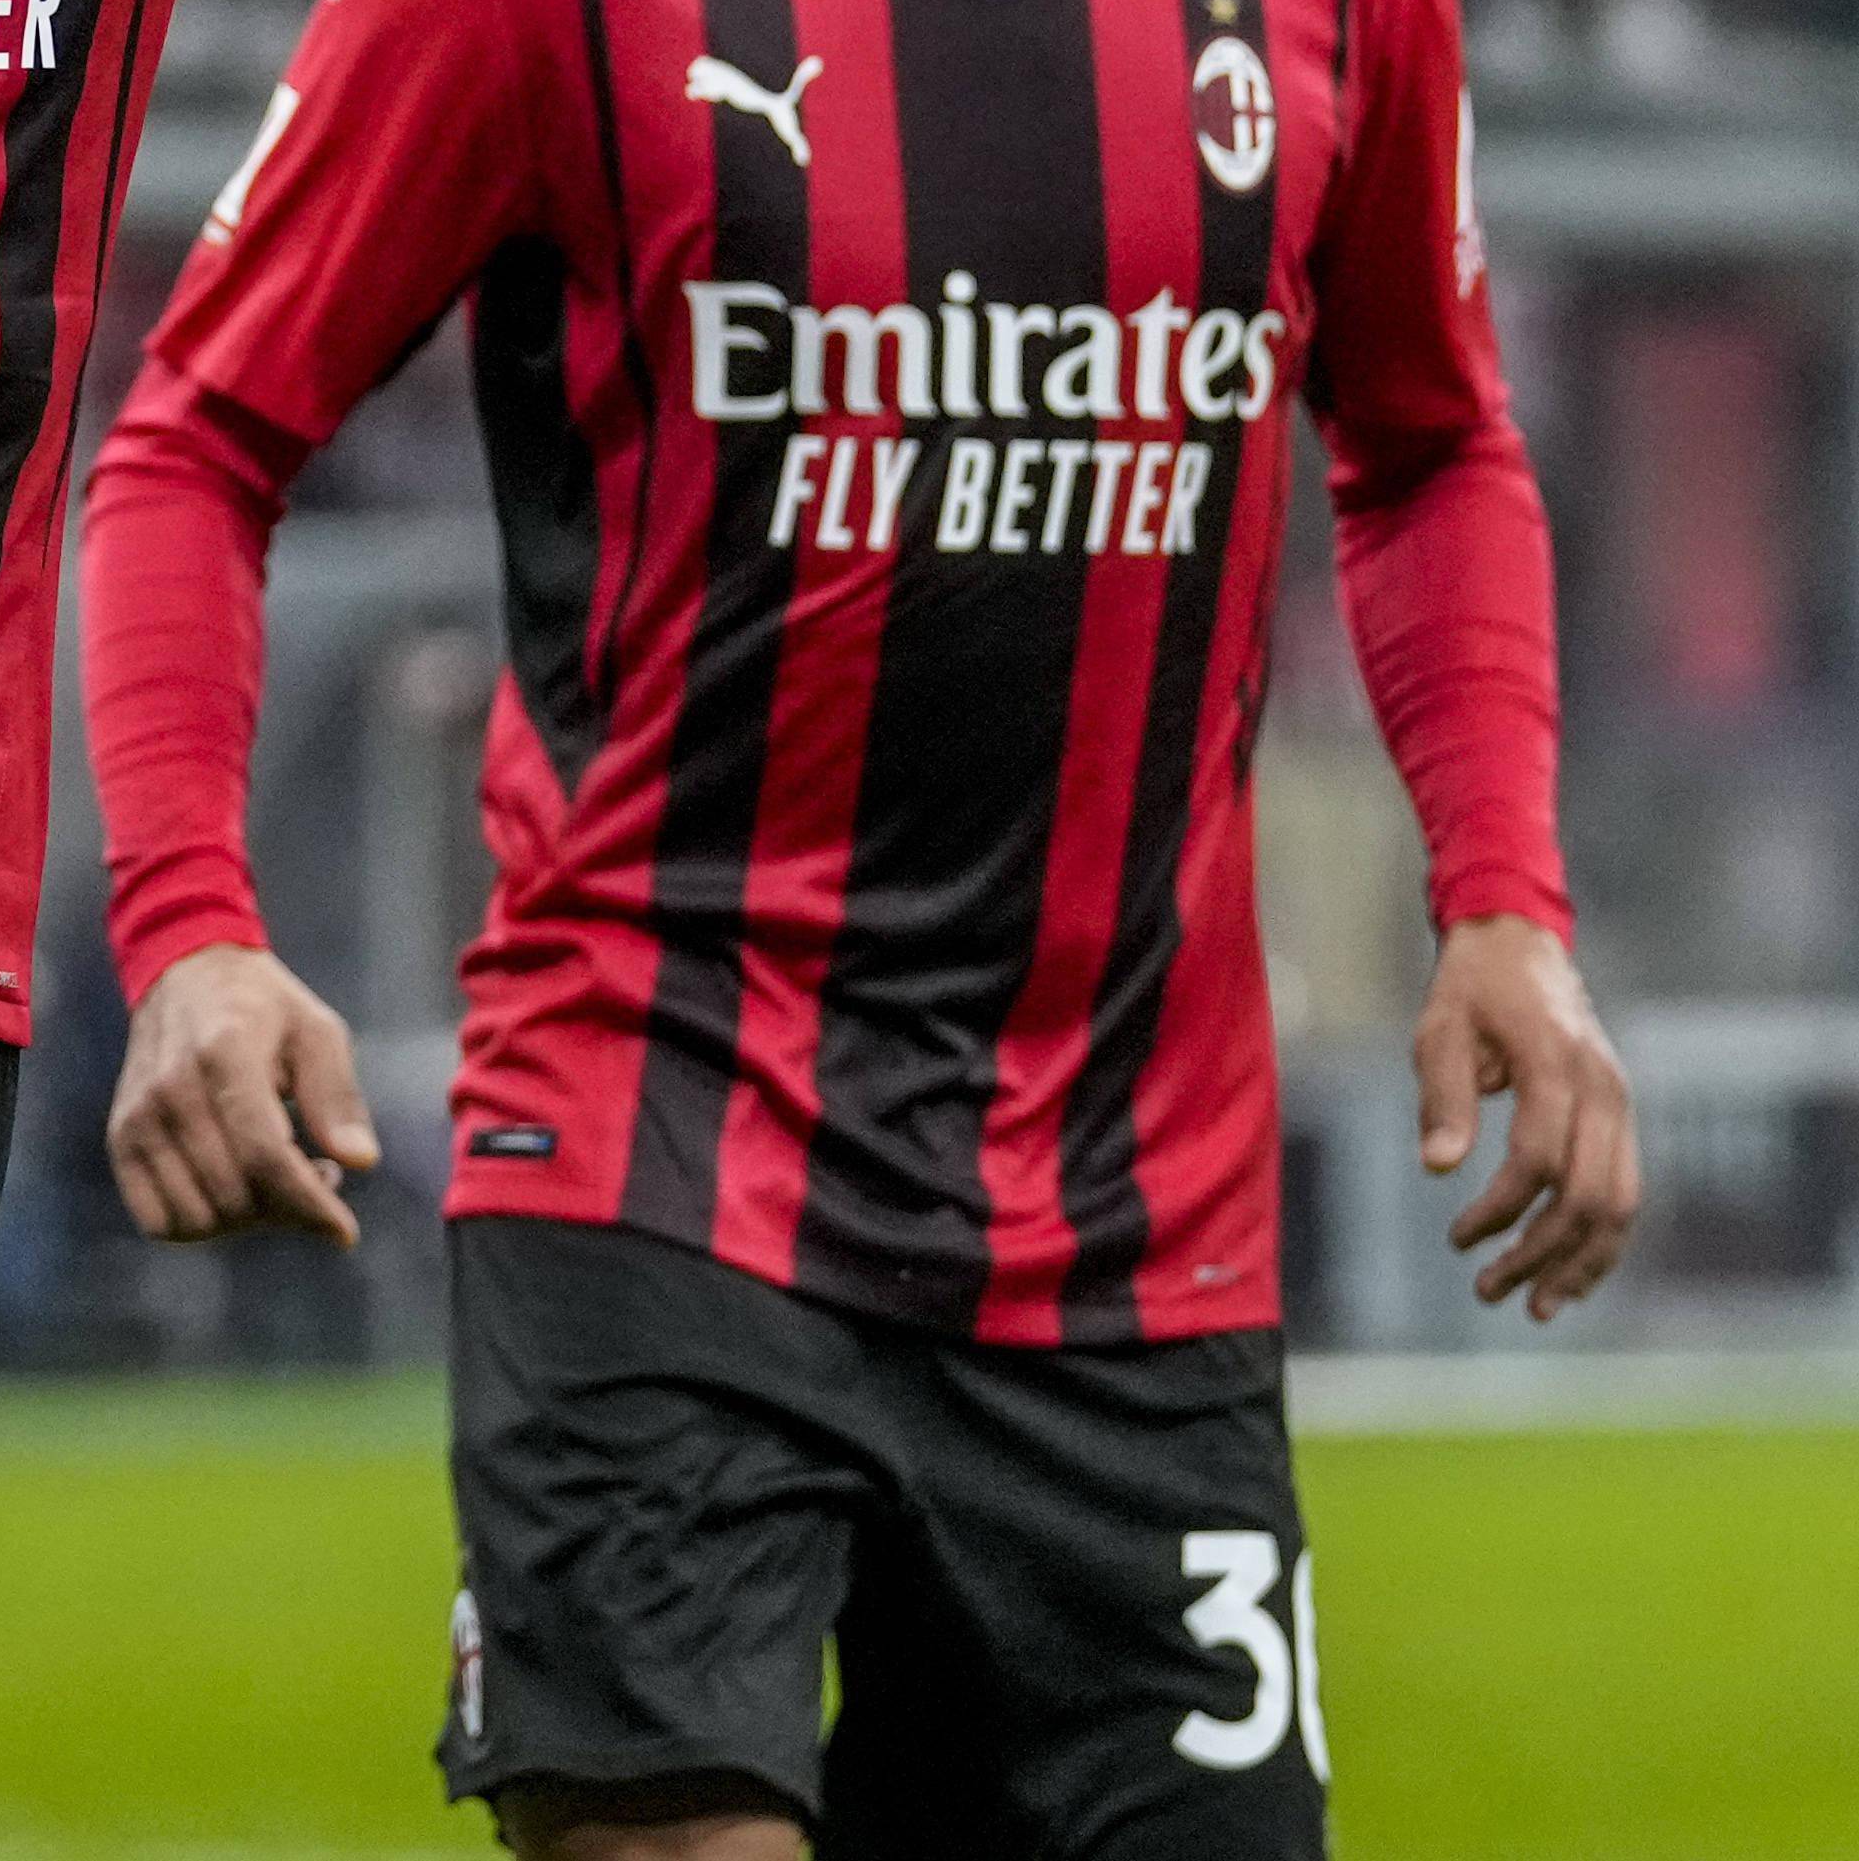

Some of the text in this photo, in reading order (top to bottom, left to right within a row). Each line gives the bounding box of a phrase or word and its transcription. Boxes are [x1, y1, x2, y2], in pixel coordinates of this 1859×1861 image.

[681, 268, 1287, 423] Emirates
[767, 433, 1214, 556] FLY BETTER
